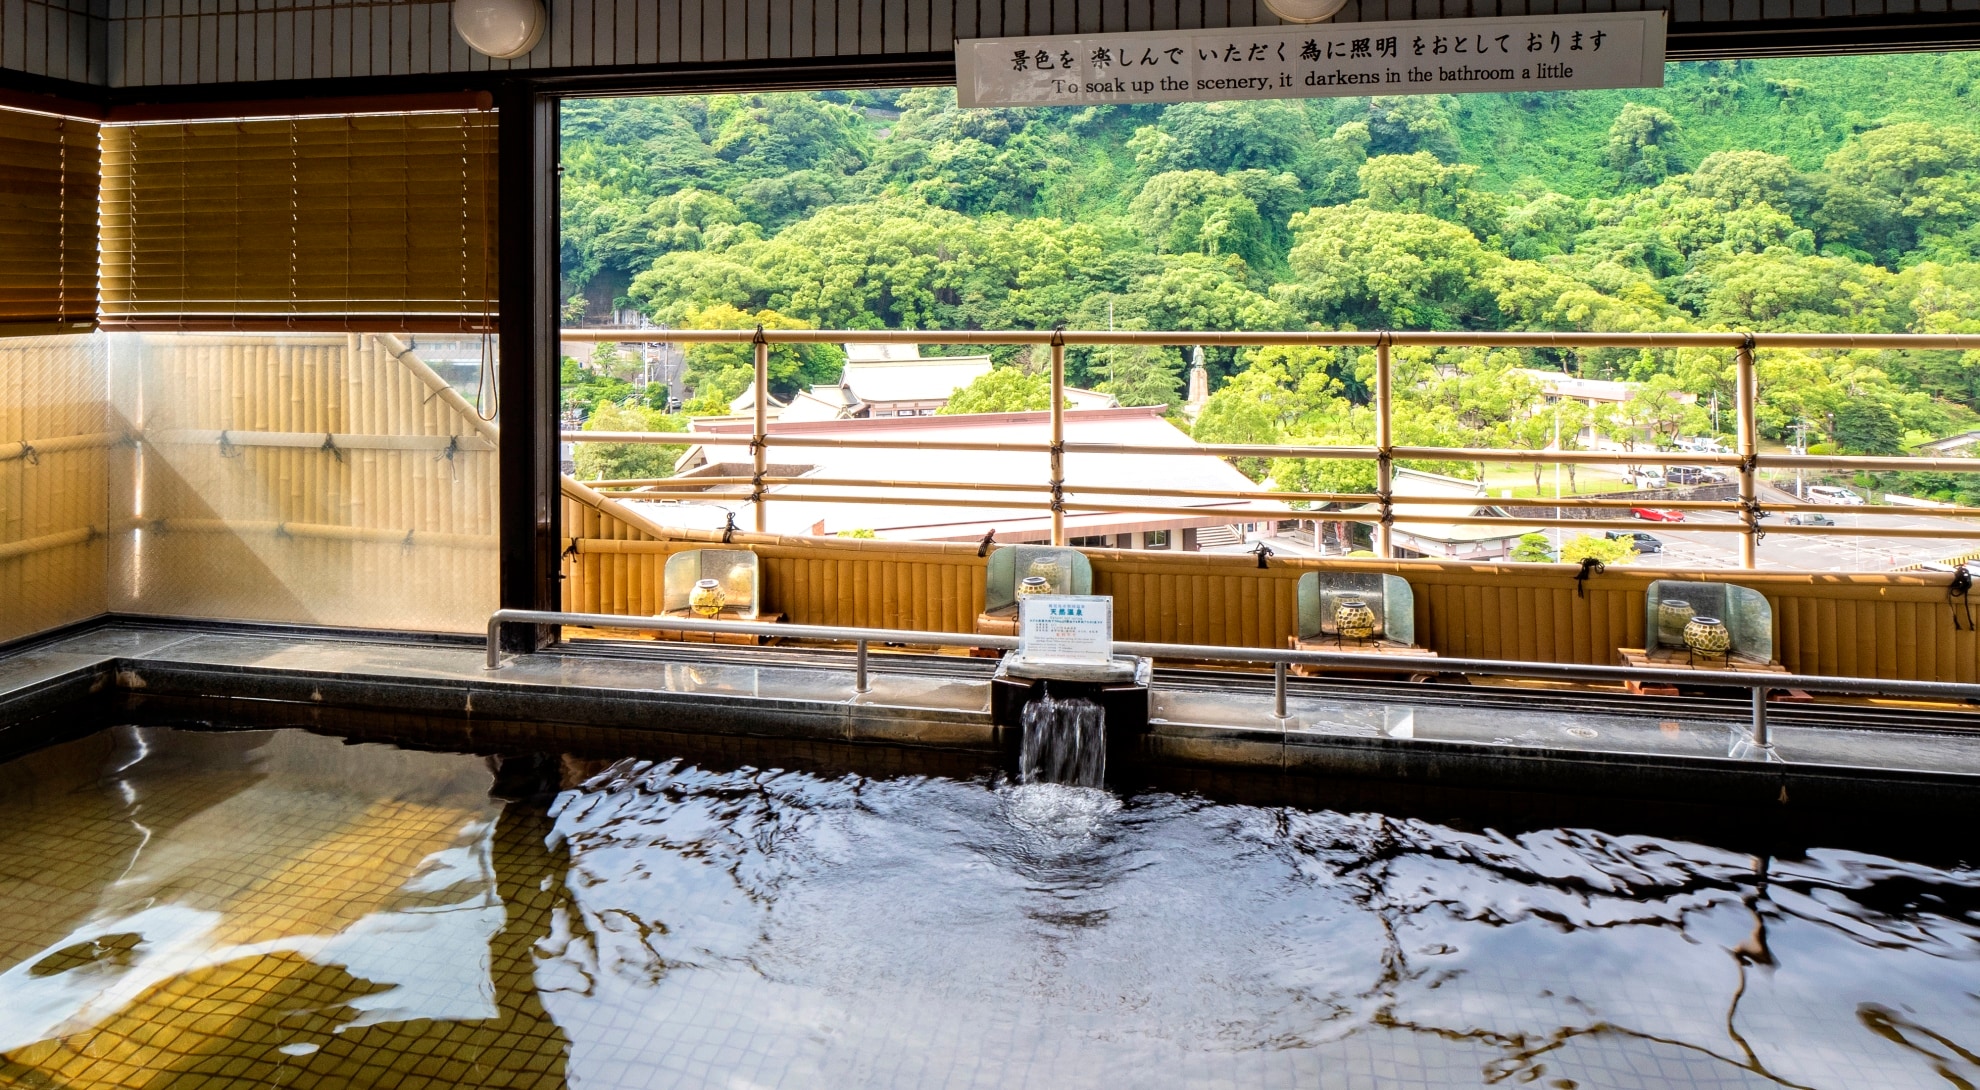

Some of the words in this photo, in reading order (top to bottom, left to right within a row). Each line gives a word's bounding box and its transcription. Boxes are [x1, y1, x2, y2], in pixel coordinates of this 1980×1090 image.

[1011, 49, 1075, 72] 景色を
[1091, 46, 1184, 70] 楽しんで
[1412, 33, 1511, 57] をおとして
[1526, 29, 1608, 53] おります
[1052, 78, 1079, 94] To
[1085, 77, 1125, 93] soak
[1132, 80, 1154, 96] up
[1160, 75, 1189, 92] the
[1197, 74, 1273, 93] scenery,
[1278, 72, 1293, 88] it
[1305, 68, 1380, 87] darkens
[1385, 67, 1401, 83] in
[1407, 66, 1433, 83] the
[1439, 64, 1514, 82] bathroom
[1522, 67, 1531, 80] a
[1537, 62, 1573, 80] little
[1050, 608, 1083, 616] 天然温泉
